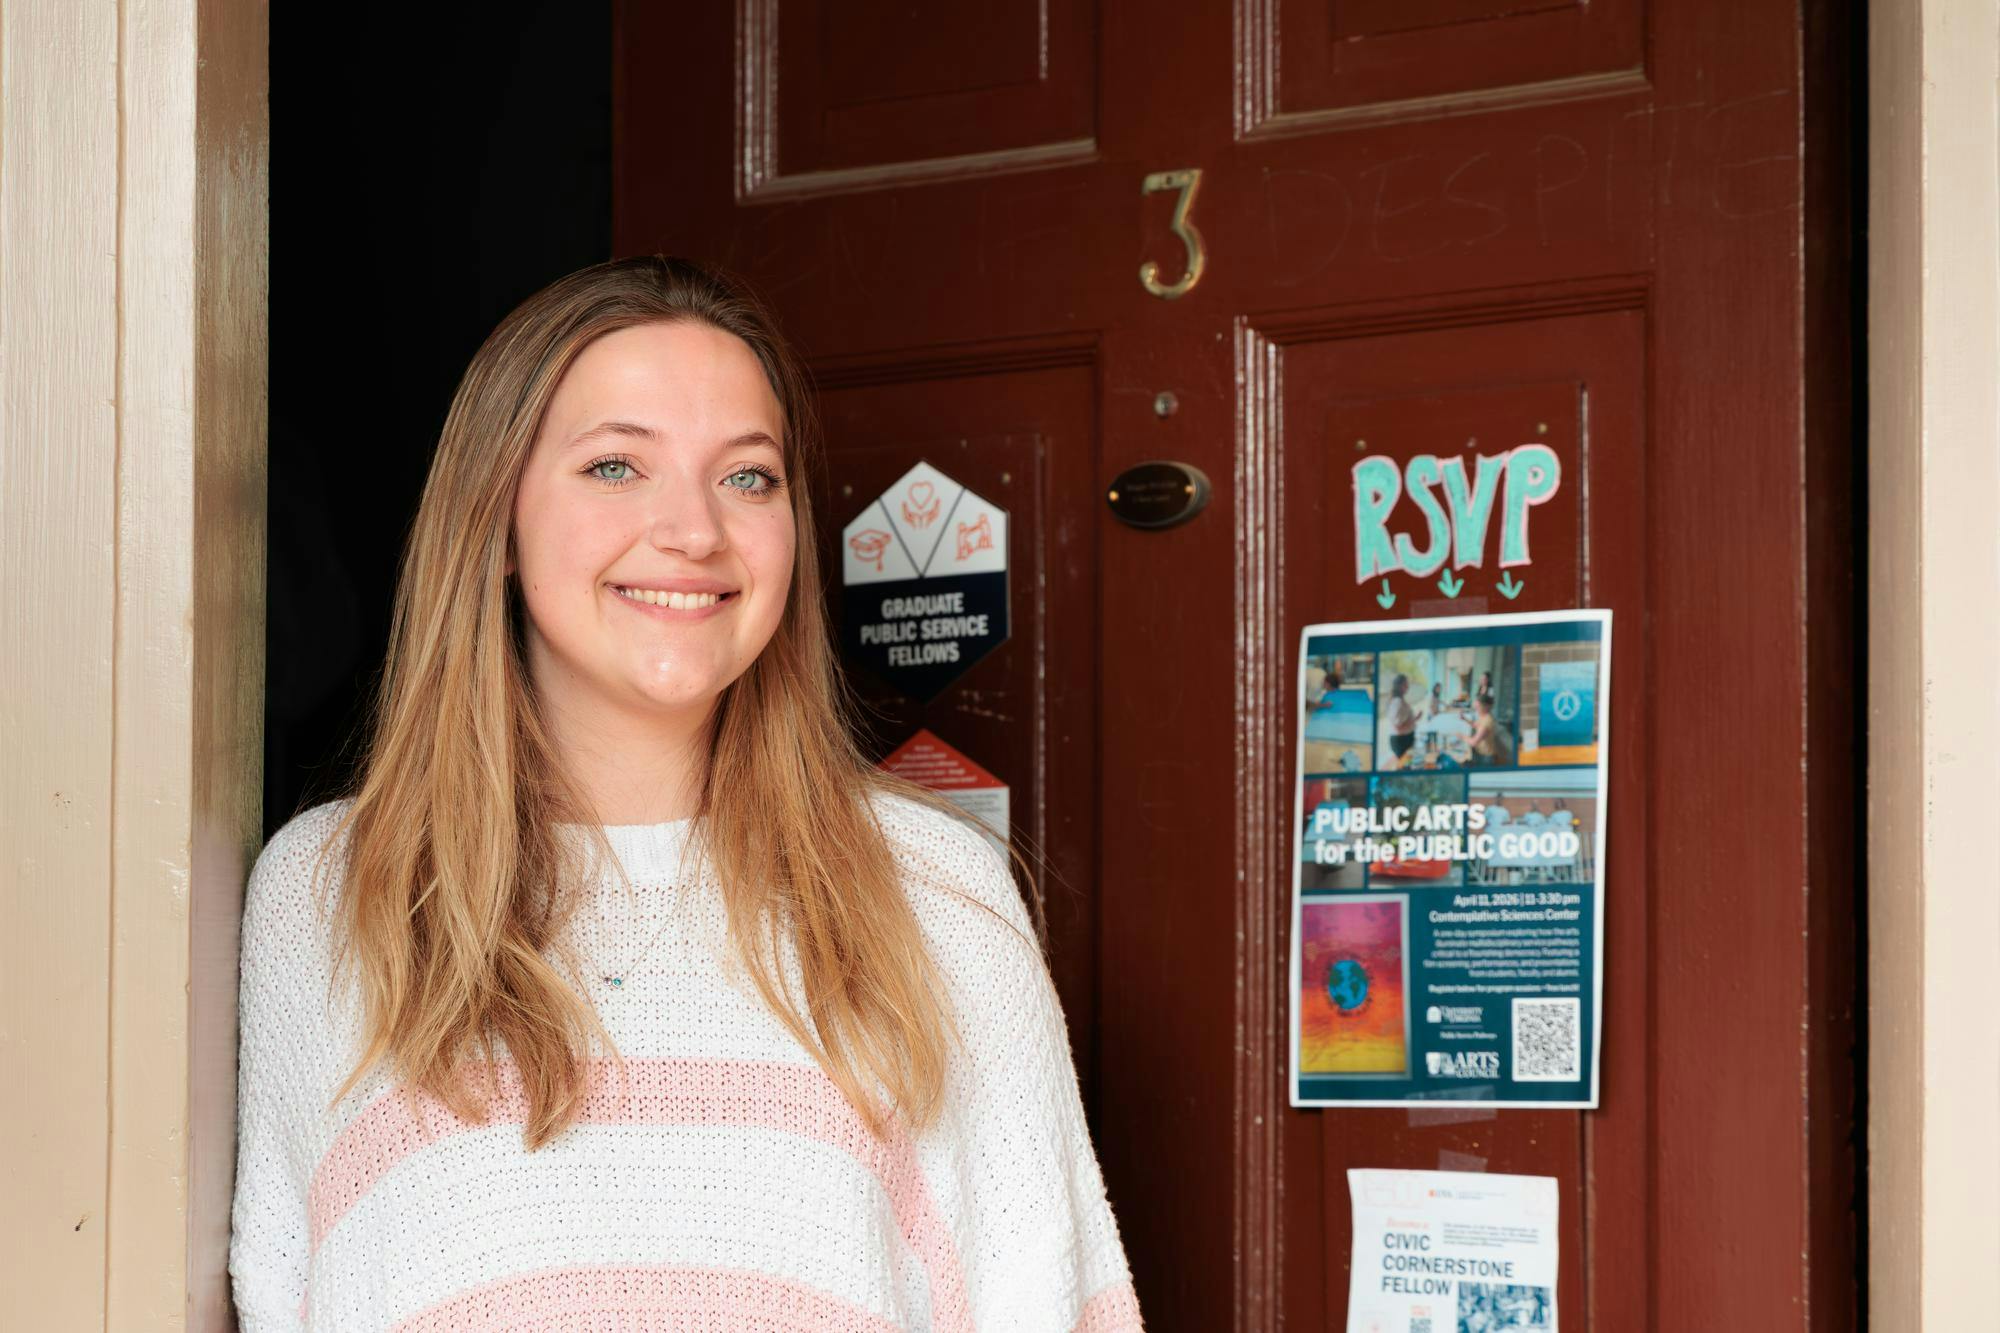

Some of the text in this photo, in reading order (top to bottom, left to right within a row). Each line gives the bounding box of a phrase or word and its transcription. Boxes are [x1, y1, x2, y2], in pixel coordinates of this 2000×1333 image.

[1139, 168, 1205, 299] 3
[1352, 444, 1561, 585] RSVP
[881, 592, 964, 619] GRADUATE
[860, 614, 989, 645] PUBLIC SERVICE
[888, 642, 960, 667] FELLOWS
[1314, 803, 1487, 834] PUBLIC ARTS
[1314, 831, 1580, 864] for the PUBLIC GOOD
[1453, 894, 1477, 907] April
[1429, 908, 1580, 923] Contemplative Sciences Center
[1454, 1051, 1500, 1069] ARTS
[1383, 1232, 1431, 1252] CIVIC
[1382, 1254, 1515, 1278] CORNERSTONE
[1381, 1275, 1452, 1296] FELLOW
